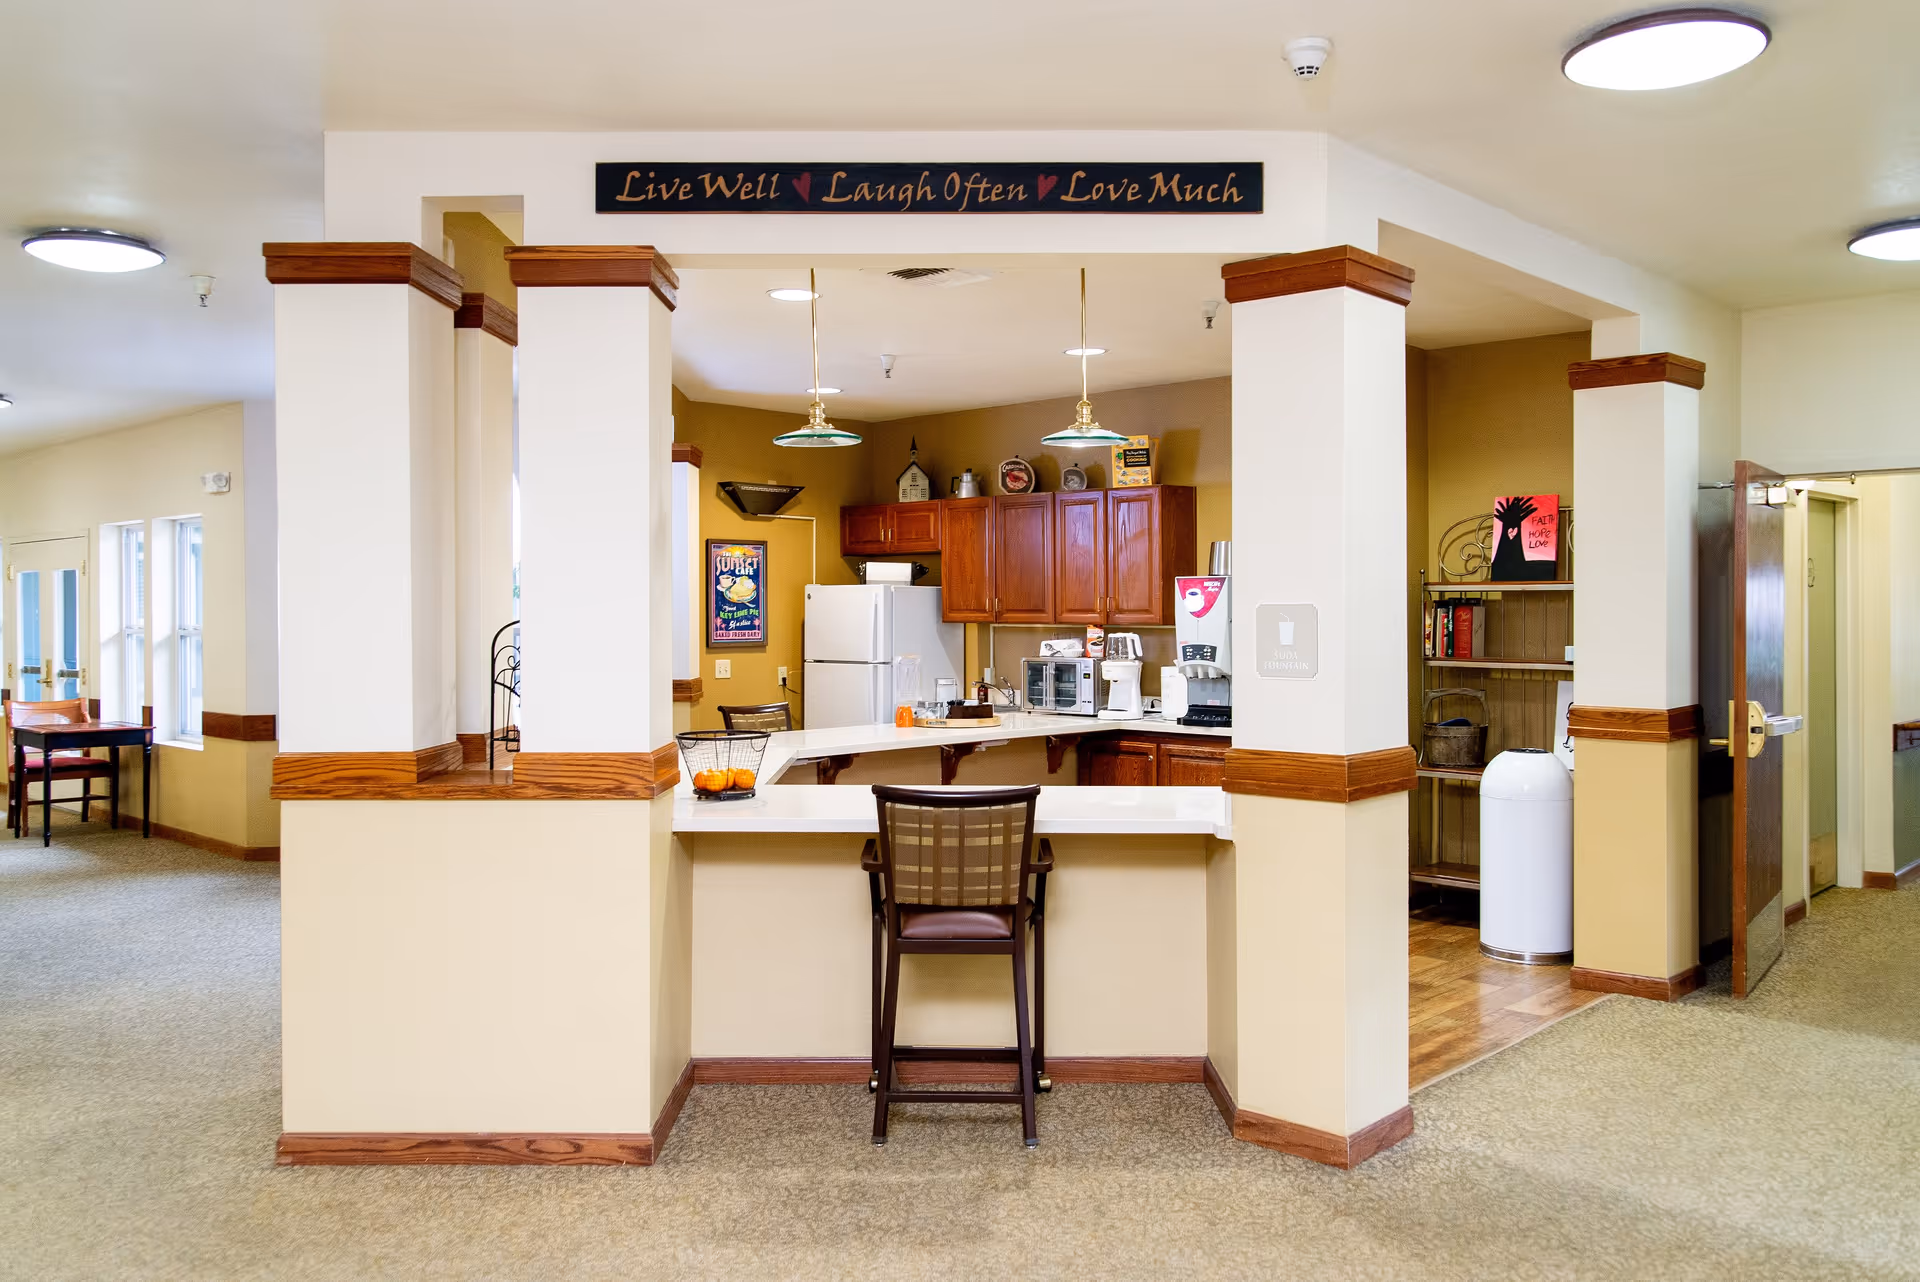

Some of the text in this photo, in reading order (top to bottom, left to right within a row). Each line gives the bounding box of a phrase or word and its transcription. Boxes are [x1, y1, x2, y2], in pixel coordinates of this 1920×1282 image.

[615, 170, 1244, 212] Live Well Laugh Often Love Much
[735, 567, 754, 575] CAFE
